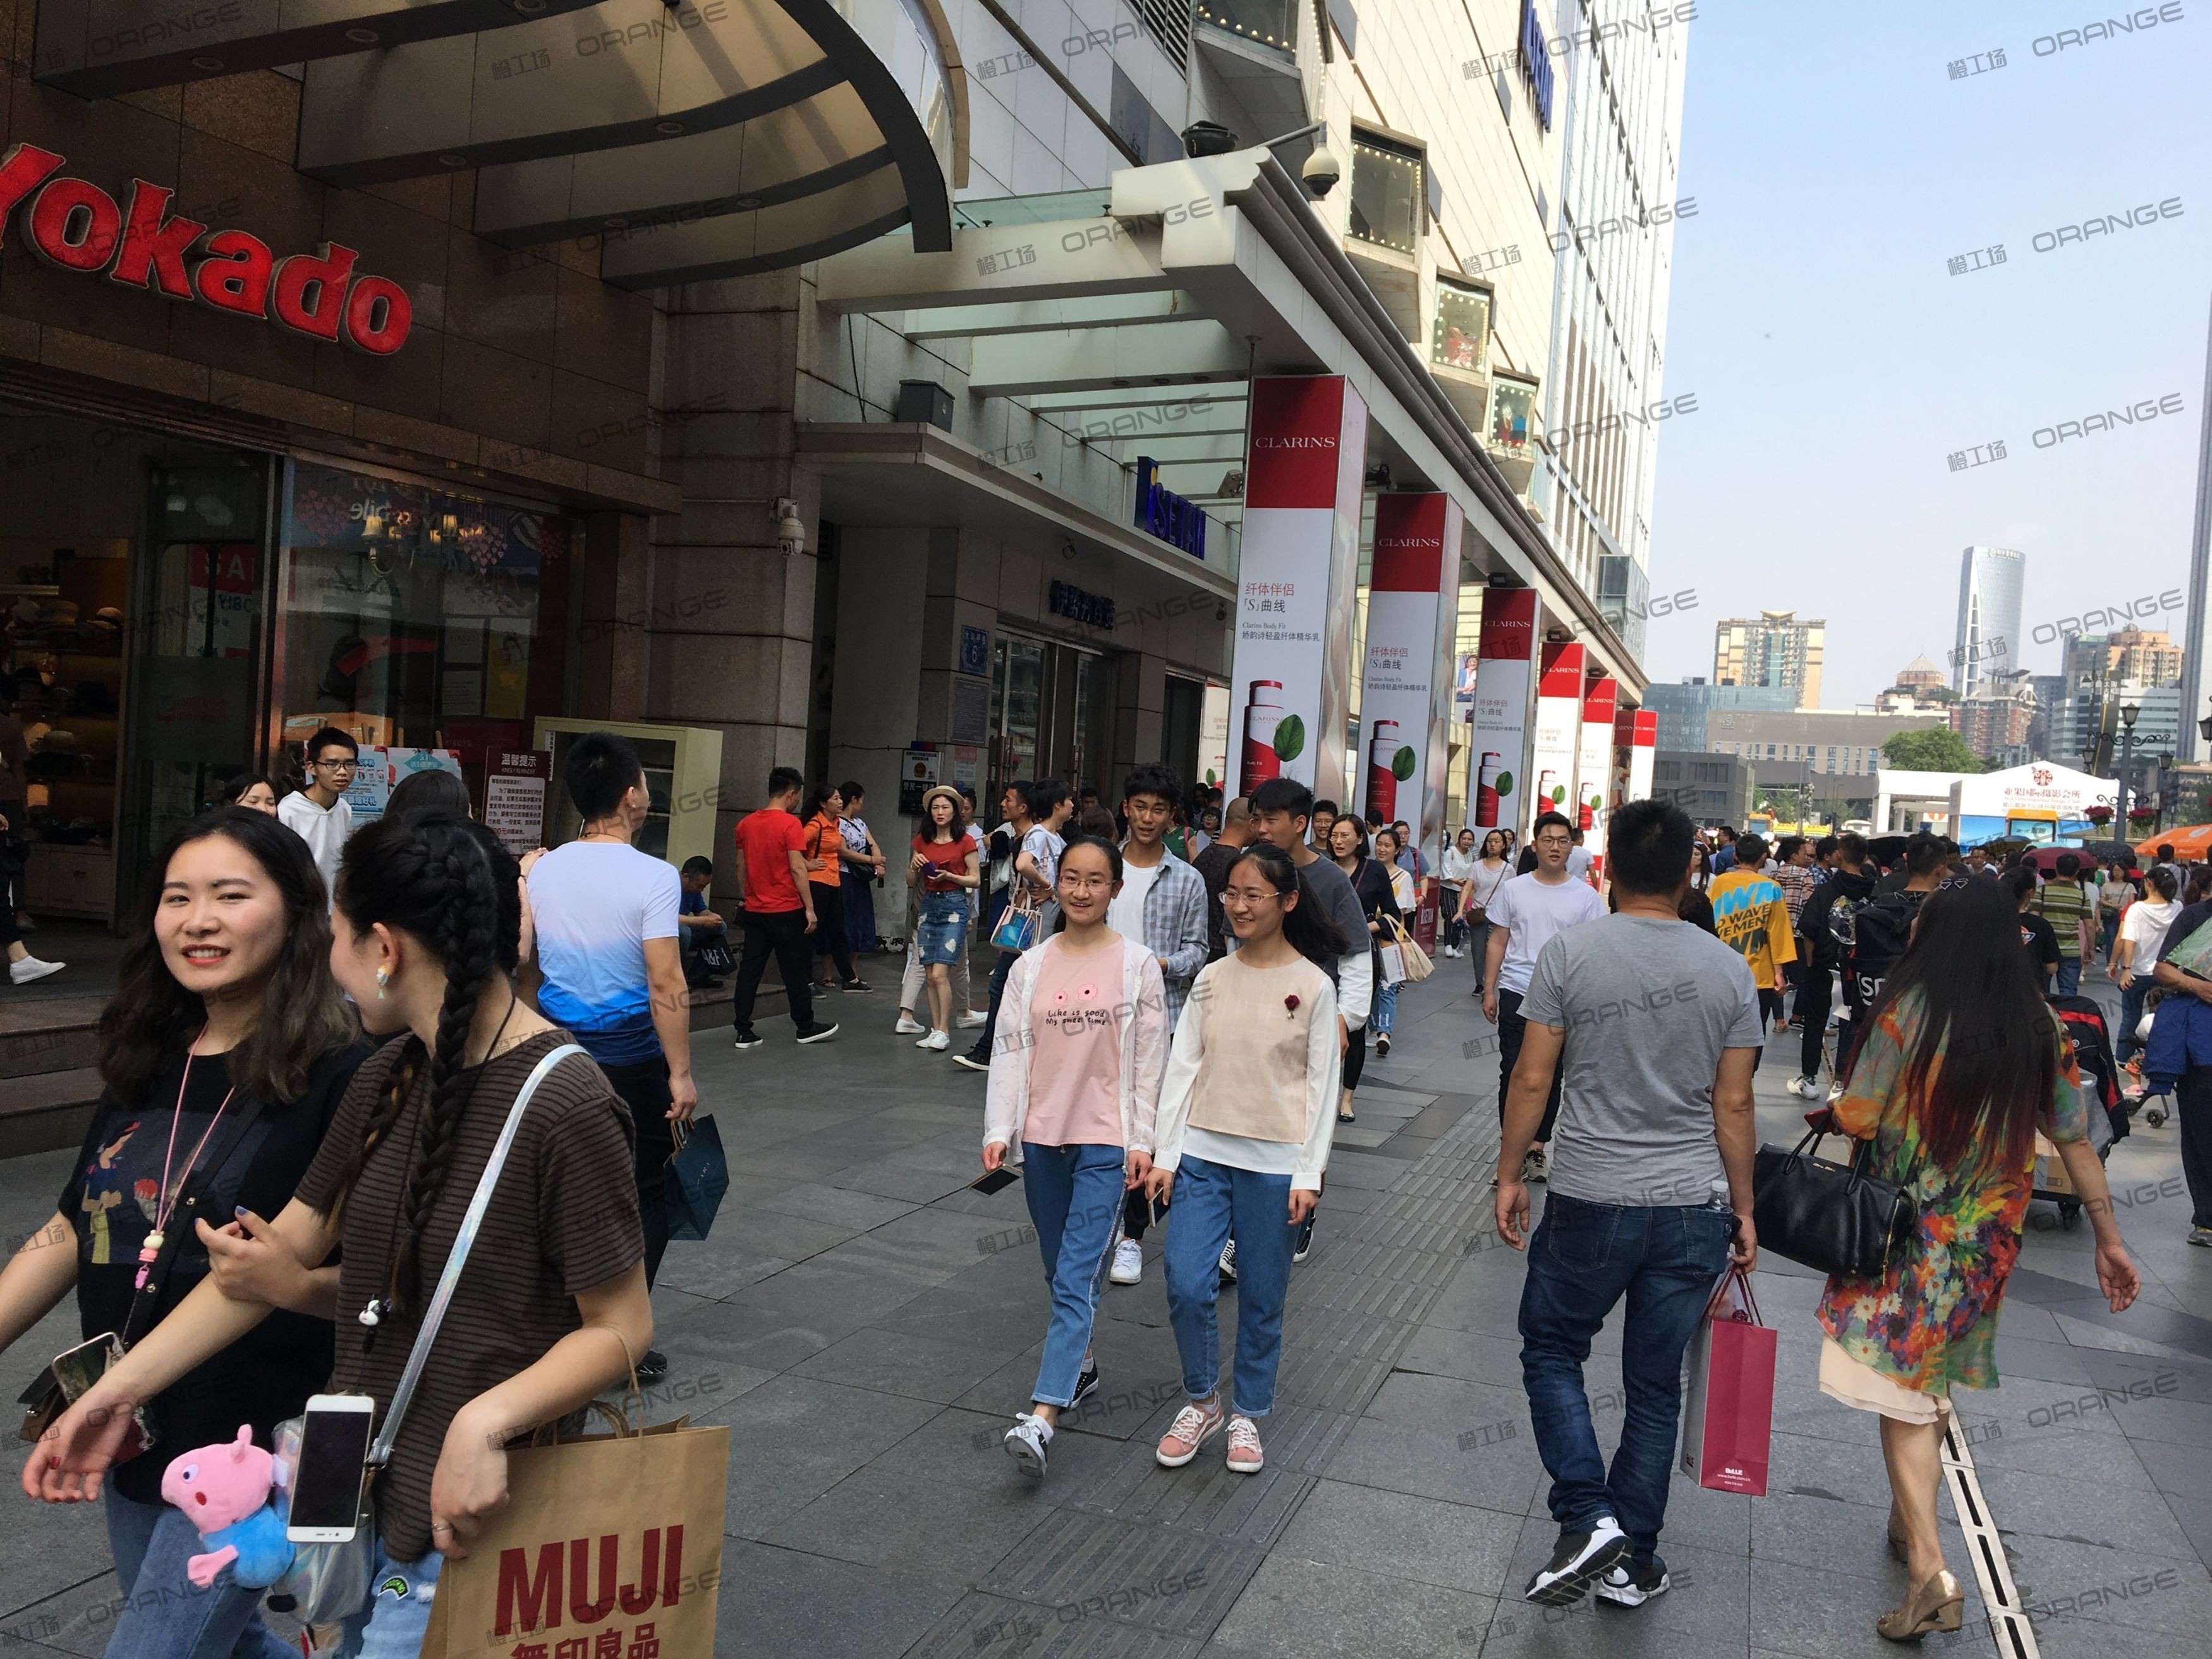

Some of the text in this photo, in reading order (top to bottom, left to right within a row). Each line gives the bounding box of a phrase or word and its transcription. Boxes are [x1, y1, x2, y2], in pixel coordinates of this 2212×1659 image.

[0, 143, 412, 355] Yokado
[1255, 437, 1335, 448] CLARINS
[1378, 538, 1440, 547] CLARINS
[1245, 581, 1294, 597] 纤体伴侣
[1244, 599, 1286, 613] 「S」曲线
[1241, 631, 1320, 642] 娇韵诗轻盈纤体精华乳
[971, 645, 978, 663] 6
[1370, 647, 1408, 658] 纤体伴侣
[1479, 698, 1508, 708] 纤体伴侣
[501, 753, 537, 767] 温馨提示
[1729, 903, 1770, 925] WAVE
[1046, 1018, 1057, 1026] My
[1087, 1017, 1106, 1026] time
[494, 1524, 684, 1637] MUJI
